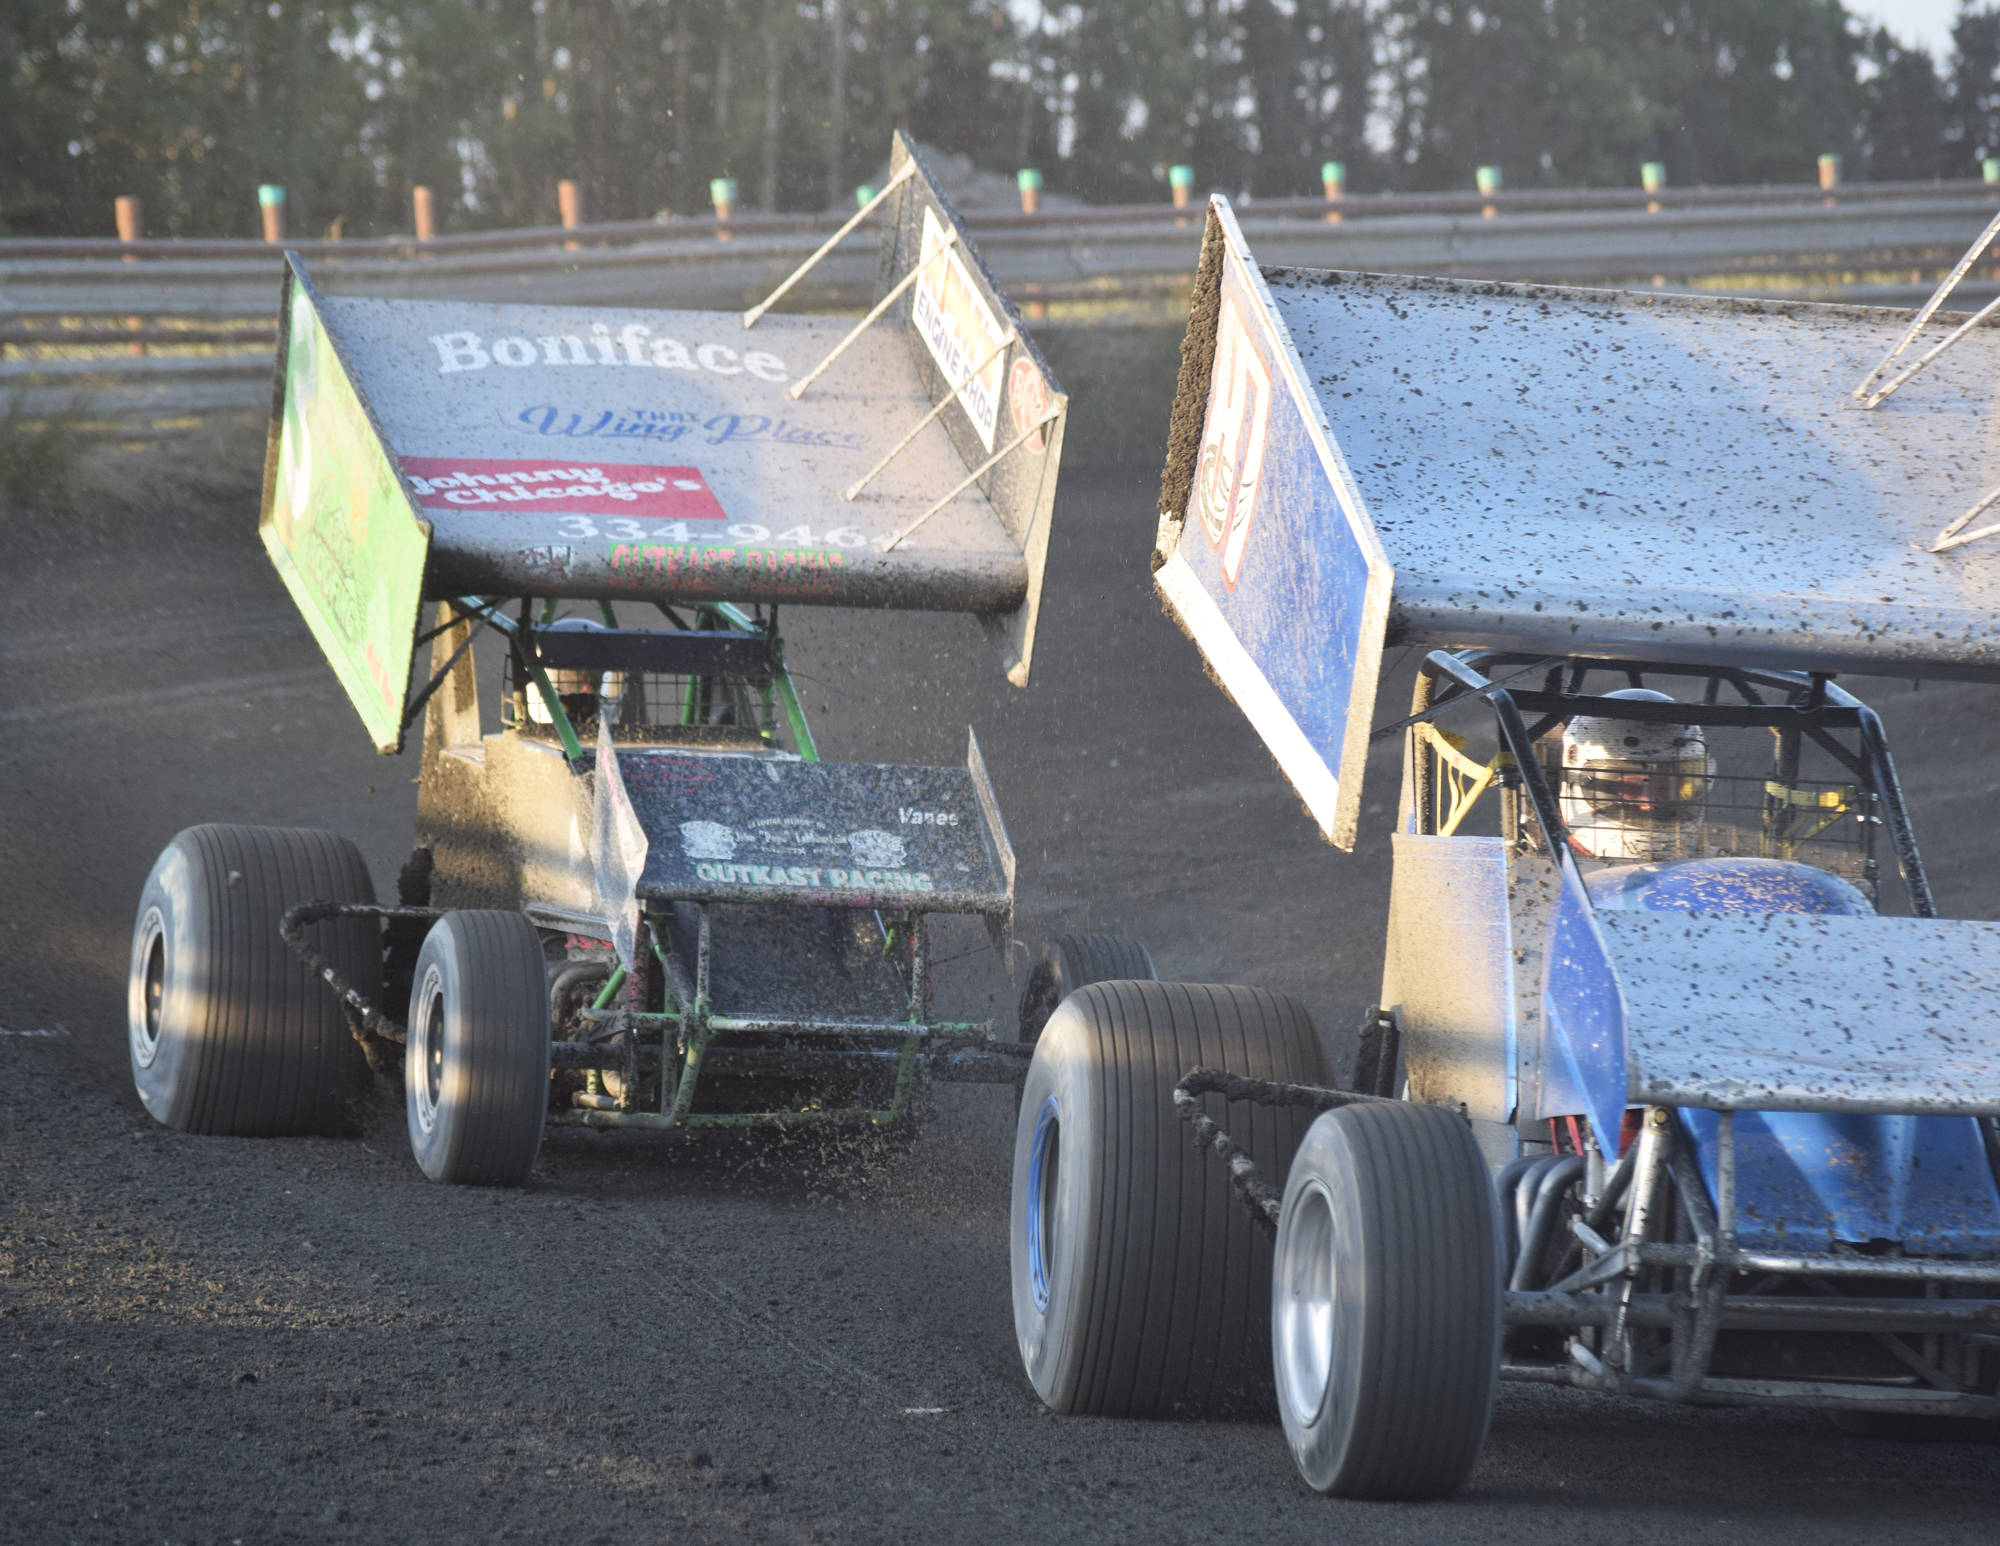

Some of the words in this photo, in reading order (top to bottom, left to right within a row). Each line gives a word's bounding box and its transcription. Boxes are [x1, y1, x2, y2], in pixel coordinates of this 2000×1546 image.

[428, 323, 789, 382] Boniface
[917, 290, 961, 377] ENGINE
[962, 362, 993, 432] SHOP
[519, 405, 688, 443] Wing
[703, 414, 872, 449] Place
[407, 467, 609, 496] Johnny
[443, 477, 702, 505] Chicago's
[696, 862, 822, 887] OUTKAST
[827, 868, 933, 892] RACING
